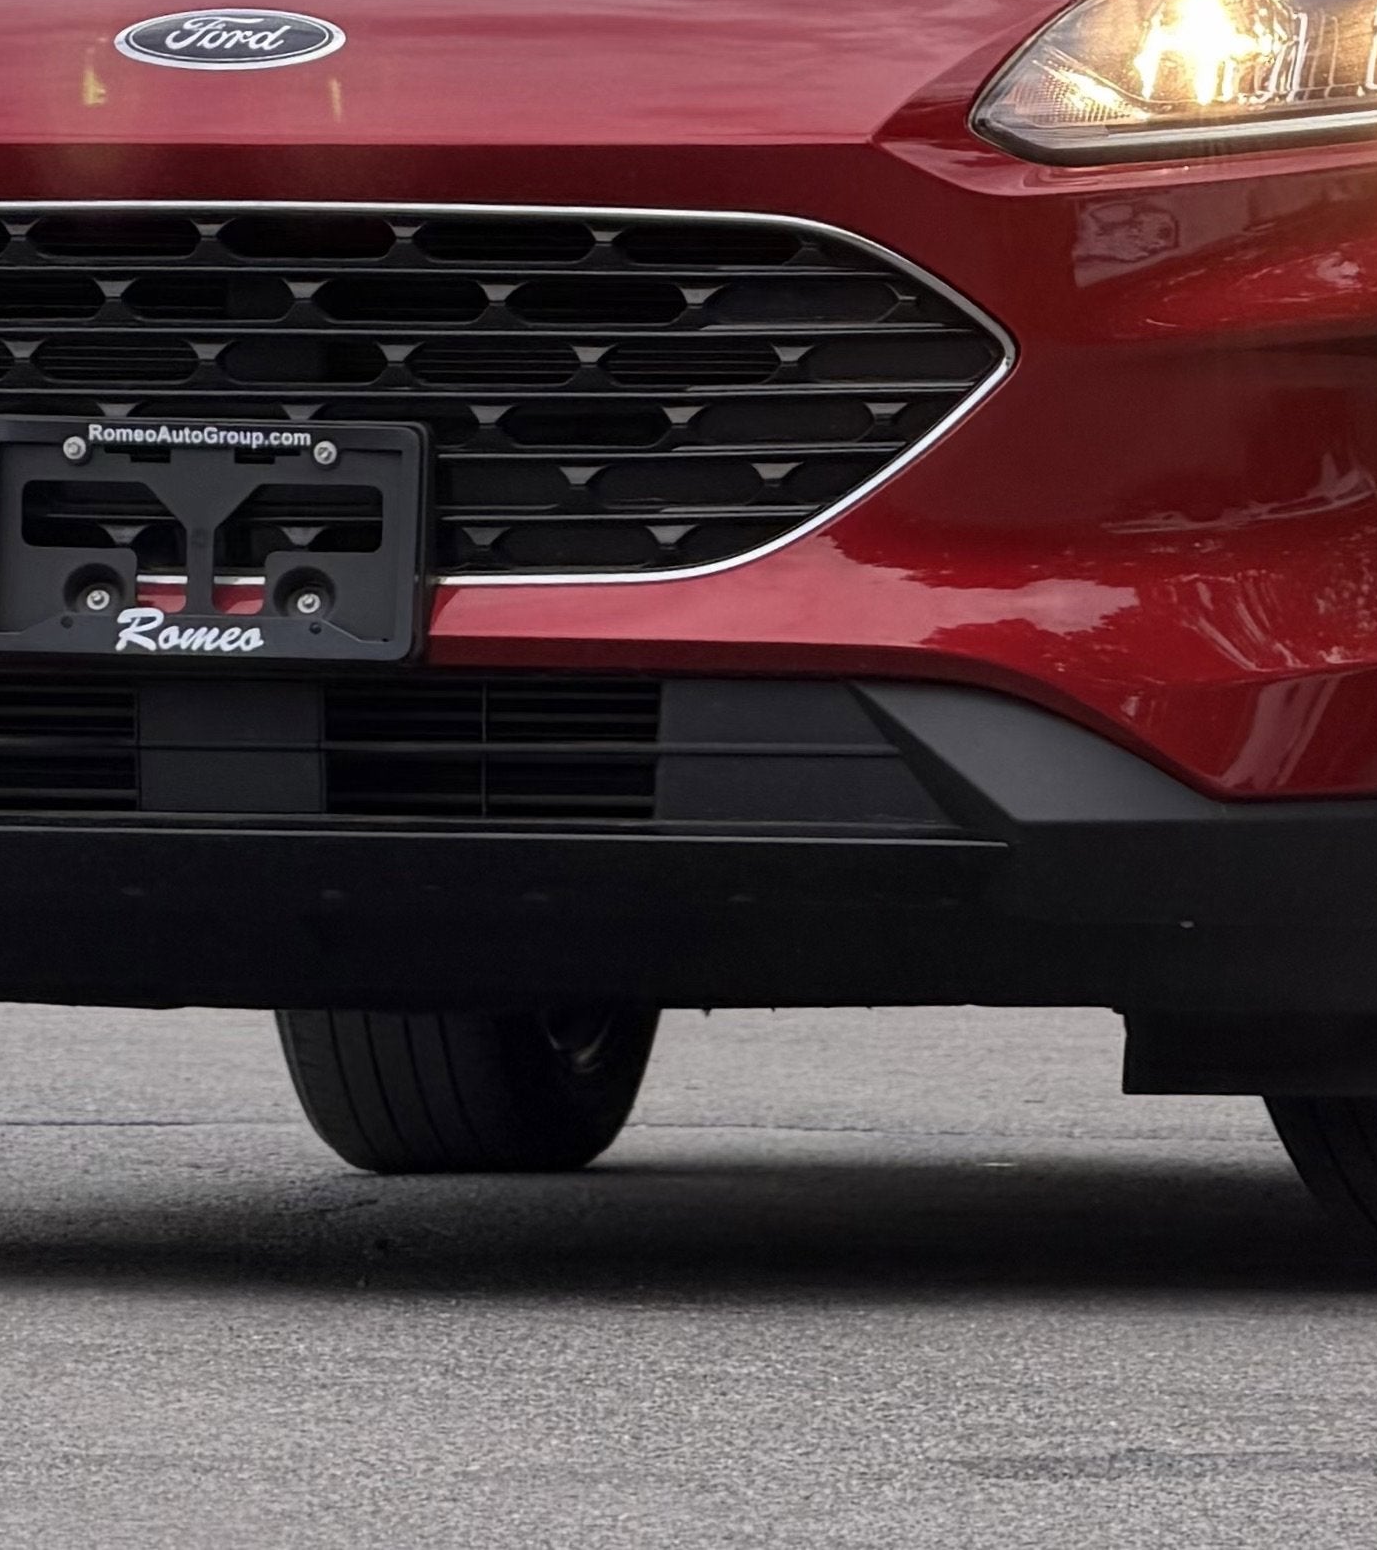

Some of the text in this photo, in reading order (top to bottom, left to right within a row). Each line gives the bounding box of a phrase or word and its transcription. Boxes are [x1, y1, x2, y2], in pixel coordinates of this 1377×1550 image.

[165, 16, 291, 50] Ford
[88, 423, 312, 448] RomeoAutoGroup.com
[115, 607, 264, 652] Romeo
